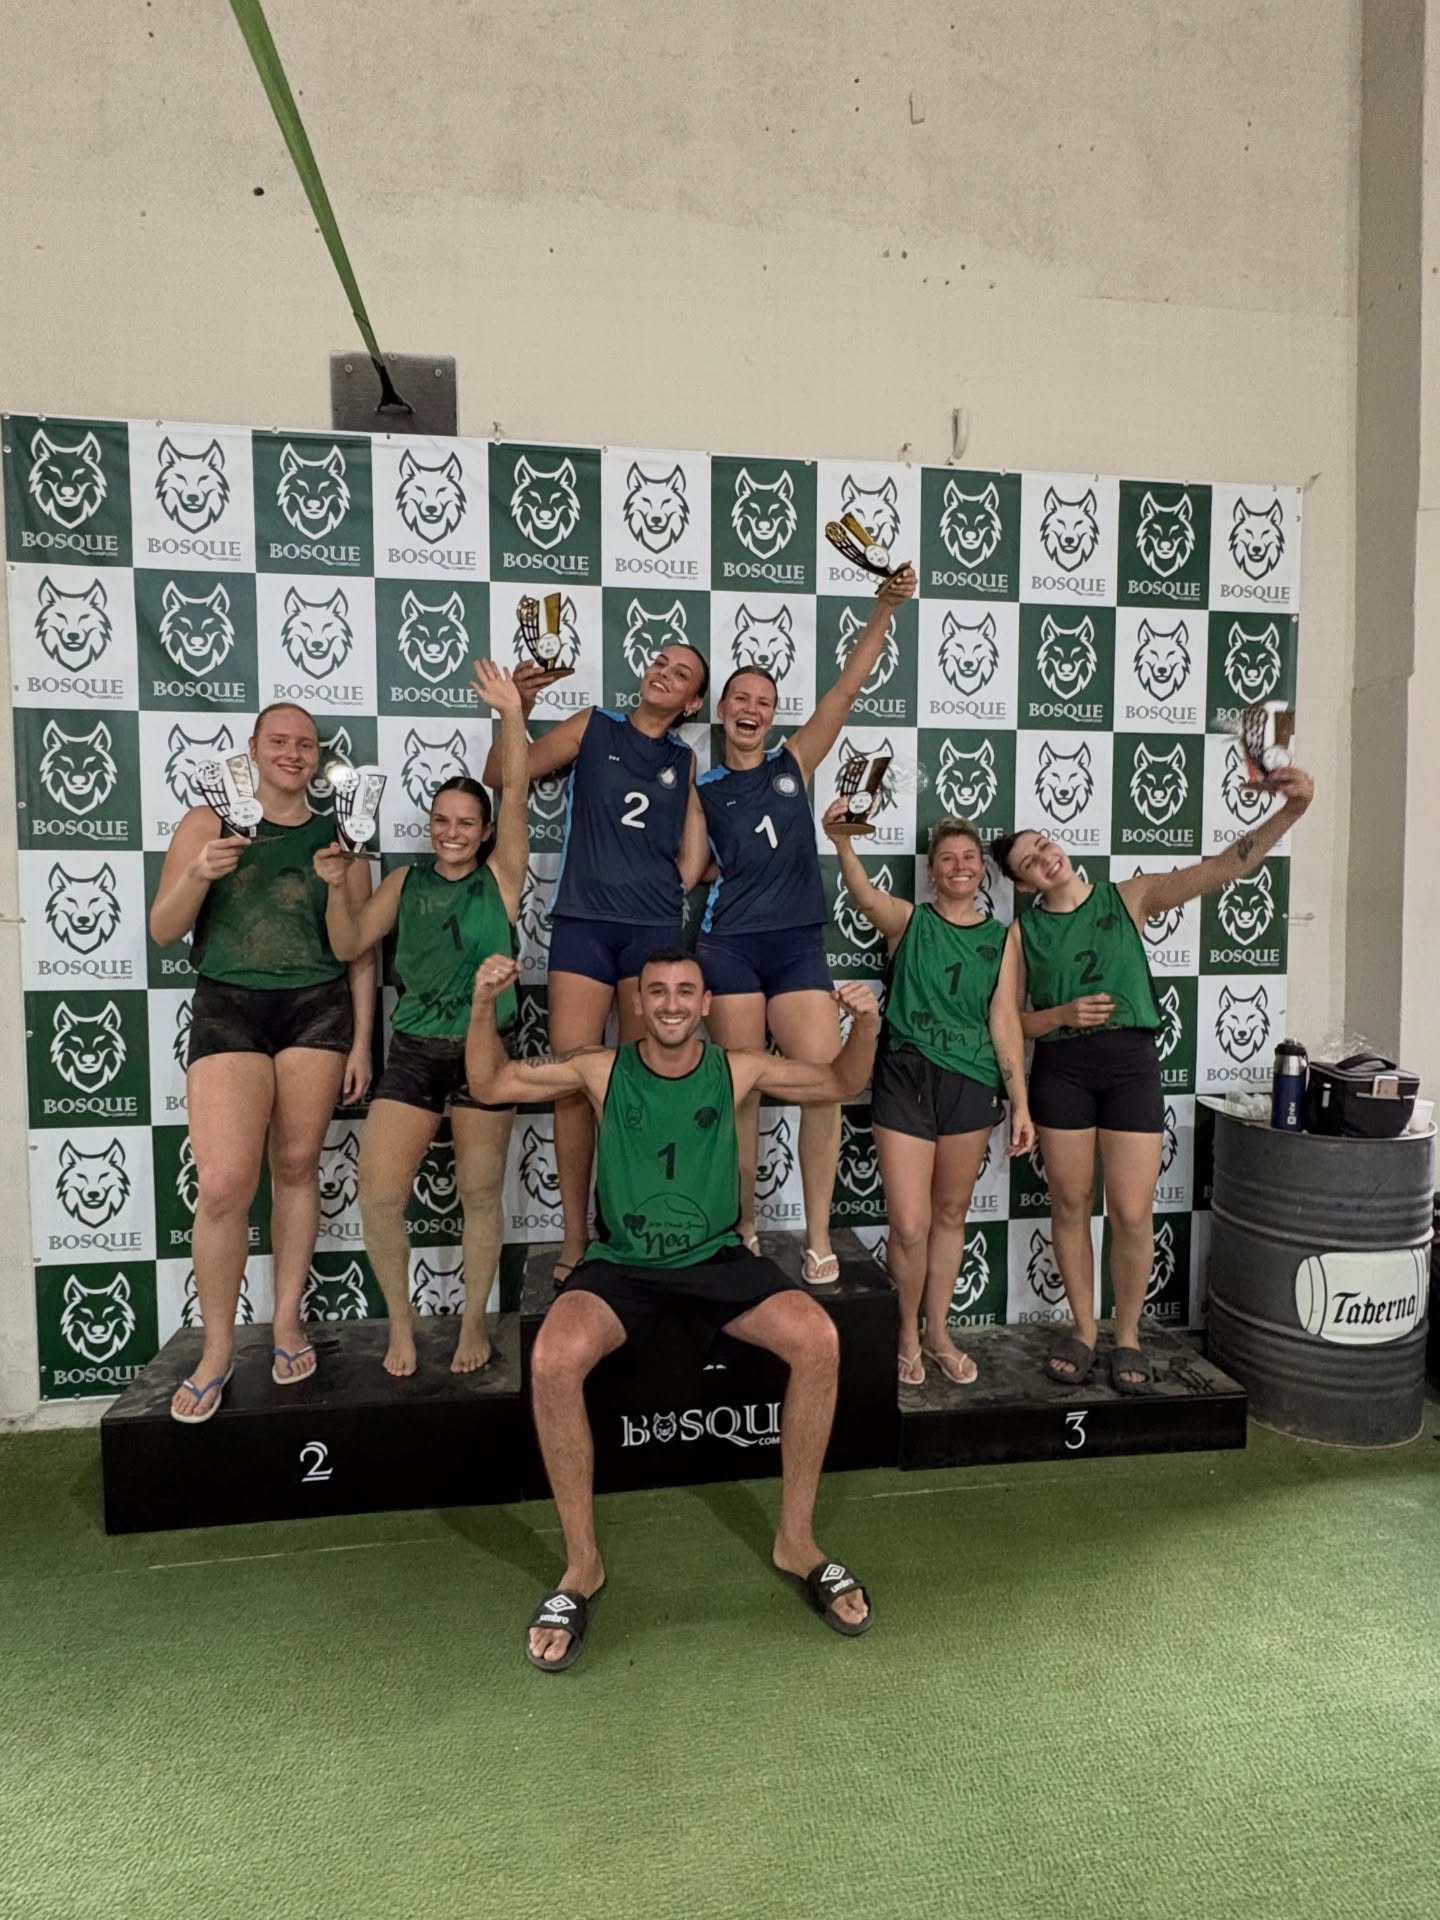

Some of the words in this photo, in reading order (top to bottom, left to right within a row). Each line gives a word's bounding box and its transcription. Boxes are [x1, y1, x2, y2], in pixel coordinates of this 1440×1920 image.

[21, 531, 118, 556] BOSQUE
[148, 538, 241, 561] BOSQUE
[269, 543, 361, 567] BOSQUE
[388, 548, 476, 570] BOSQUE
[502, 552, 590, 576] BOSQUE
[615, 558, 698, 580] BOSQUE
[723, 562, 805, 584] BOSQUE
[829, 567, 885, 585] BOSQ
[931, 570, 1008, 592] BOSQUE
[1031, 575, 1106, 596] BOSQUE
[1127, 580, 1200, 600] BOSQUE
[1220, 584, 1290, 604] BOSQUE
[27, 676, 123, 699] BOSQUE
[152, 680, 246, 702] BOSQUE
[273, 684, 364, 705] BOSQUE
[391, 686, 478, 707] BOSQUE
[534, 691, 590, 711] SQUE
[850, 699, 906, 718] SQUE
[929, 700, 1006, 720] BOSQUE
[1028, 702, 1104, 723] BOSQUE
[1125, 705, 1197, 724] BOSQUE
[621, 791, 650, 829] 2
[32, 819, 128, 841] BOSQUE
[394, 823, 431, 838] BOS
[528, 824, 565, 843] OSQ
[754, 815, 778, 849] 1
[1040, 828, 1100, 846] OSQUE
[1121, 828, 1194, 847] BOSQUE
[1213, 829, 1255, 844] BOS
[442, 915, 463, 951] 1
[826, 953, 884, 971] BOSQ
[1074, 949, 1104, 986] 2
[1209, 949, 1280, 967] BOSQUE
[38, 959, 133, 980] BOSQUE
[944, 962, 963, 996] 1
[43, 1096, 138, 1118] BOSQUE
[657, 1142, 677, 1181] 1
[1020, 1193, 1053, 1206] BOS
[512, 1213, 594, 1230] BOSQE
[754, 1203, 802, 1222] SQUE
[48, 1232, 142, 1252] BOSQUE
[318, 1223, 361, 1240] SQU
[1331, 1290, 1416, 1325] Taberna
[1064, 1410, 1088, 1450] 3
[299, 1441, 333, 1482] 2
[830, 1578, 855, 1593] umbro
[539, 1613, 569, 1625] umbro
